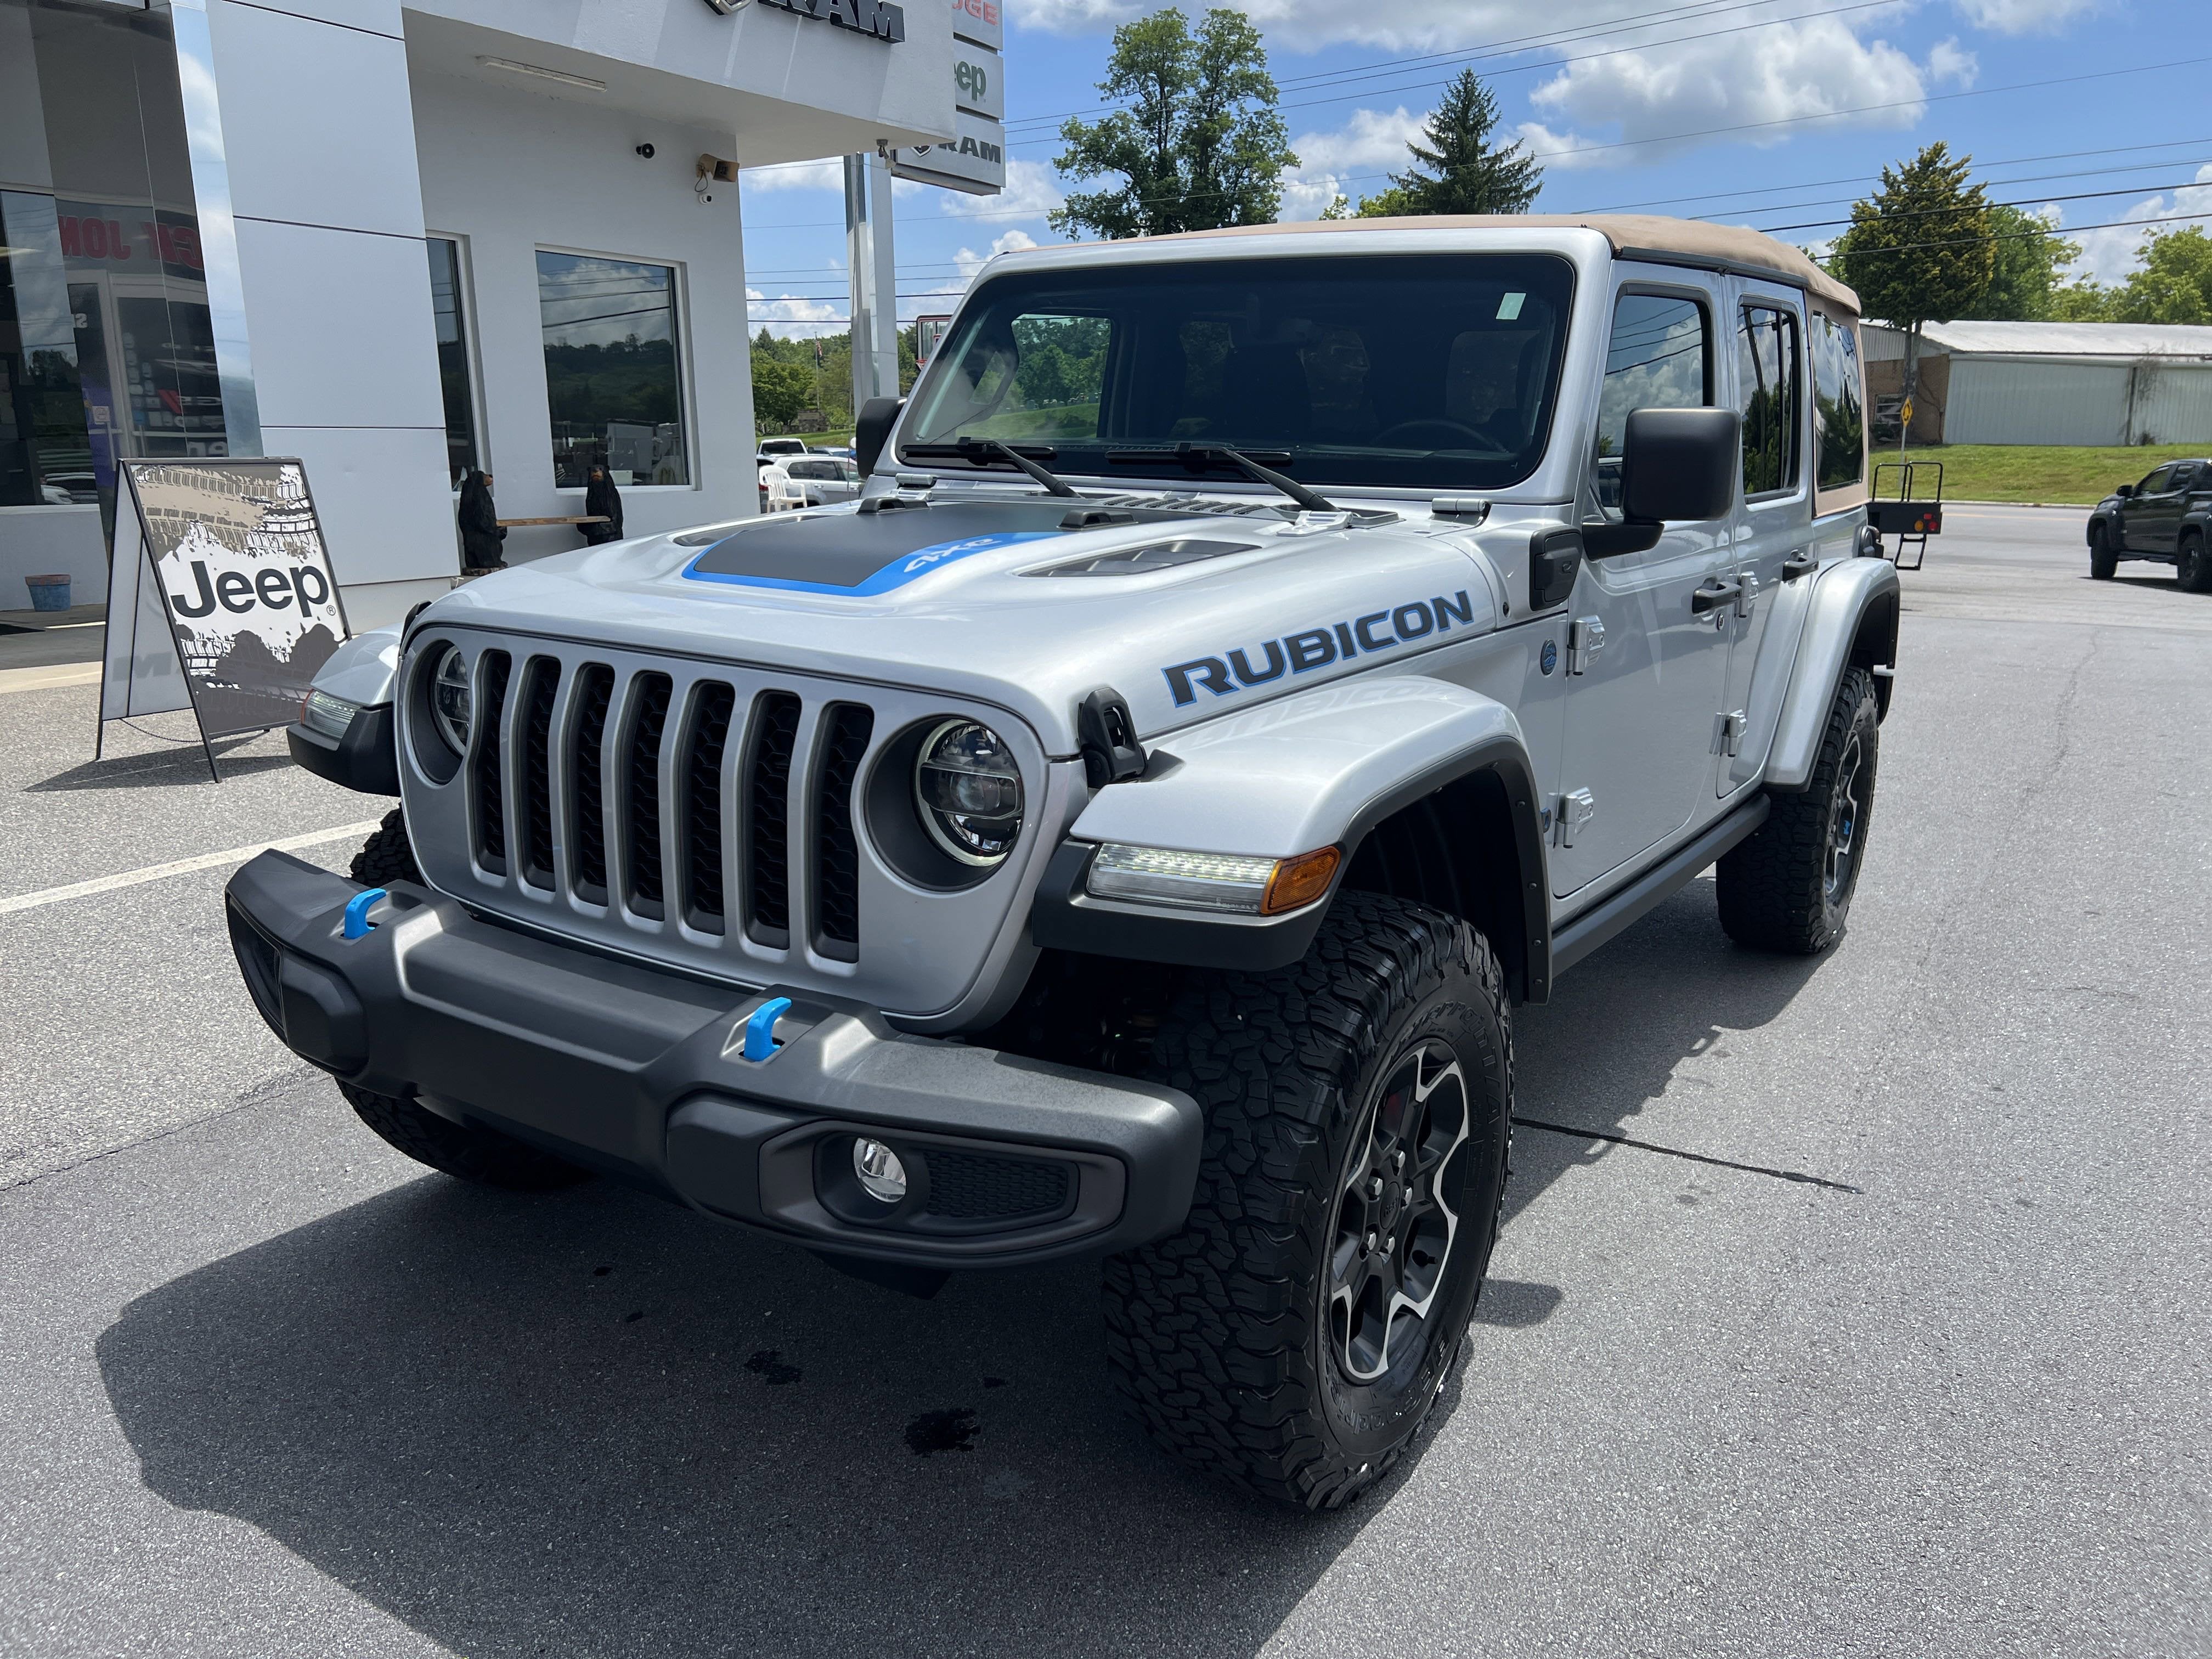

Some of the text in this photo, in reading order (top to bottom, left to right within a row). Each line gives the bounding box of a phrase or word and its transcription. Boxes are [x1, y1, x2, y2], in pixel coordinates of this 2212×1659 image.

[953, 61, 986, 101] ep
[170, 561, 329, 618] Jeep
[1161, 589, 1474, 708] RUBICON
